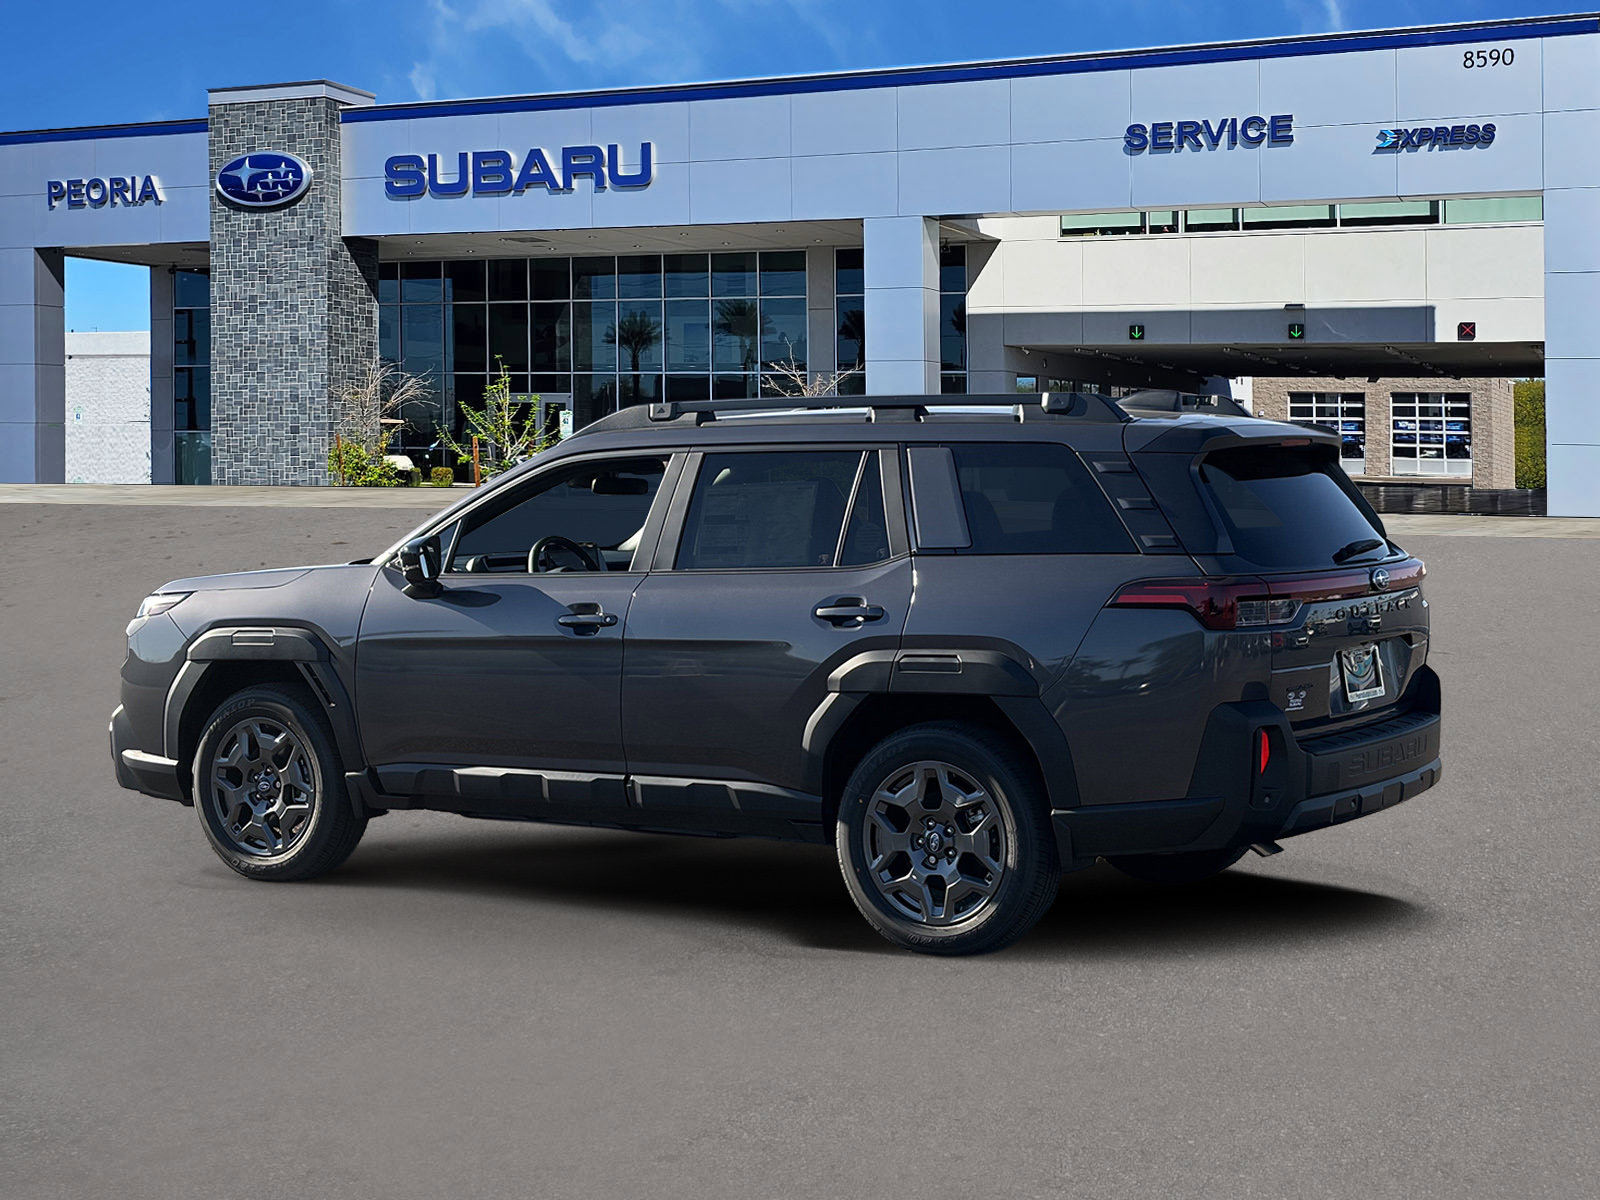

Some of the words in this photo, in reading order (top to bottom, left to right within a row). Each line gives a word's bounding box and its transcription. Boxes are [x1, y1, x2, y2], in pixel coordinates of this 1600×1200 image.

[1463, 48, 1515, 69] 8590
[1124, 114, 1294, 151] SERVICE
[1376, 123, 1497, 149] EXPRESS
[384, 142, 653, 198] SUBARU
[47, 175, 162, 209] PEORIA
[1348, 733, 1428, 777] SUBARU
